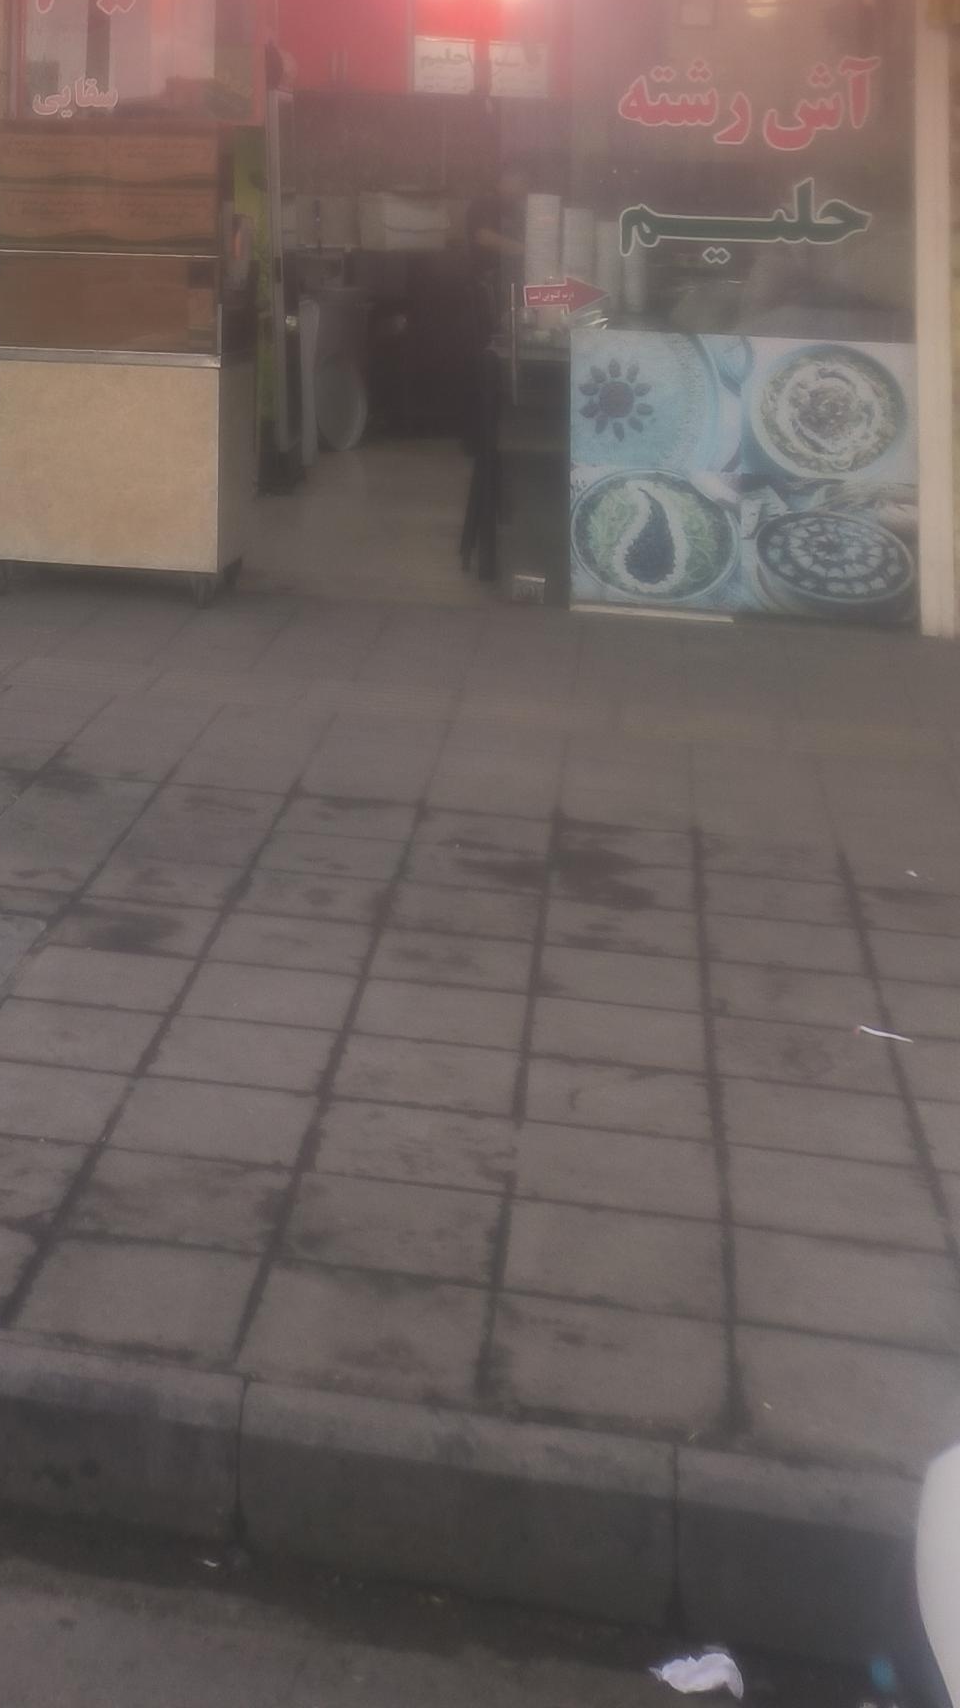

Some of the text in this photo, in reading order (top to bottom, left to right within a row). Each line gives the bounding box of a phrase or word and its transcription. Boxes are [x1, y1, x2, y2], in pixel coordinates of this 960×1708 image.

[31, 77, 119, 119] سقایی
[618, 58, 752, 144] رشته
[762, 55, 881, 151] آش
[619, 176, 873, 265] حلیم
